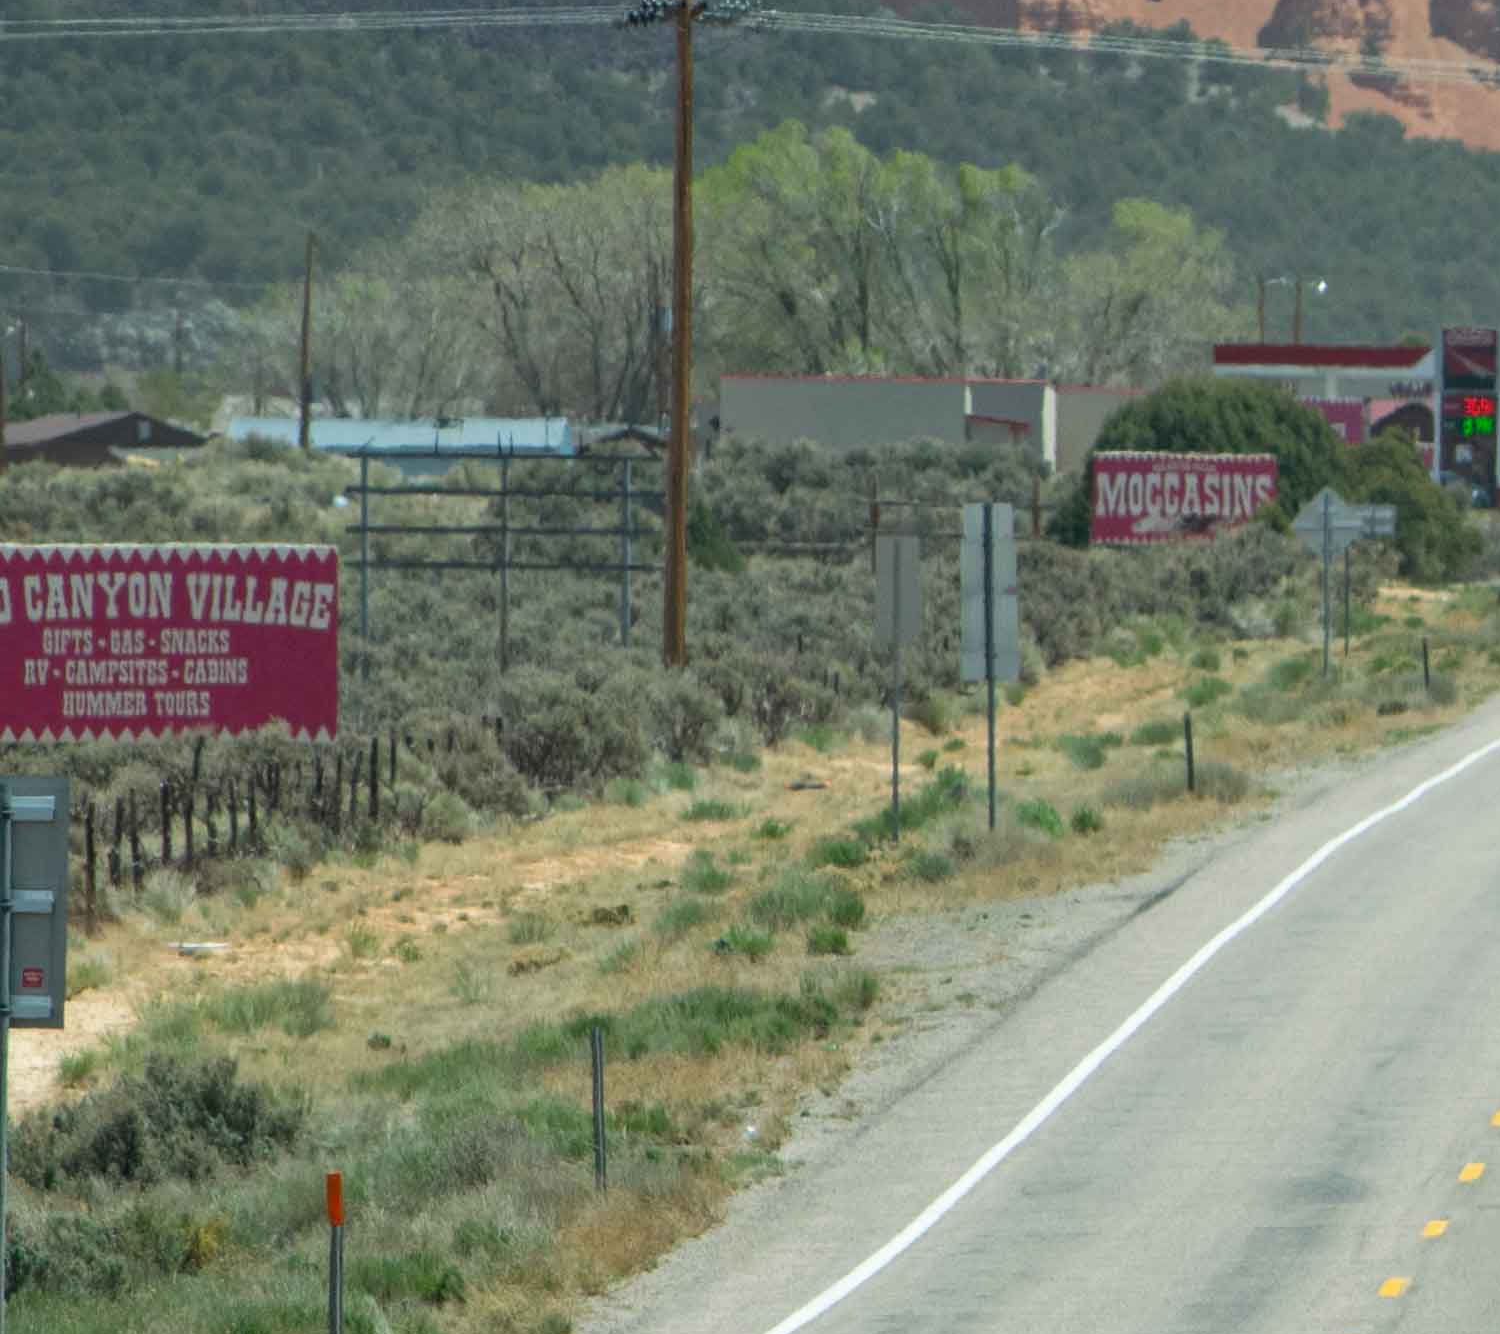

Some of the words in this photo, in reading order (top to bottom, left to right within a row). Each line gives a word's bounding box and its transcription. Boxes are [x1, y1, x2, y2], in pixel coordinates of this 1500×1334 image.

[1096, 472, 1272, 517] MOCCASINS
[23, 571, 173, 620] CANYON
[186, 573, 335, 630] VILLAGE
[43, 628, 93, 654] GIFTS
[111, 628, 144, 654] GAS
[160, 628, 231, 654] SNACKS
[24, 660, 49, 685] RV
[65, 659, 168, 685] CAMPSITES
[183, 658, 249, 684] CABINS
[63, 690, 147, 716] HUMMER
[154, 690, 211, 716] TOURS
